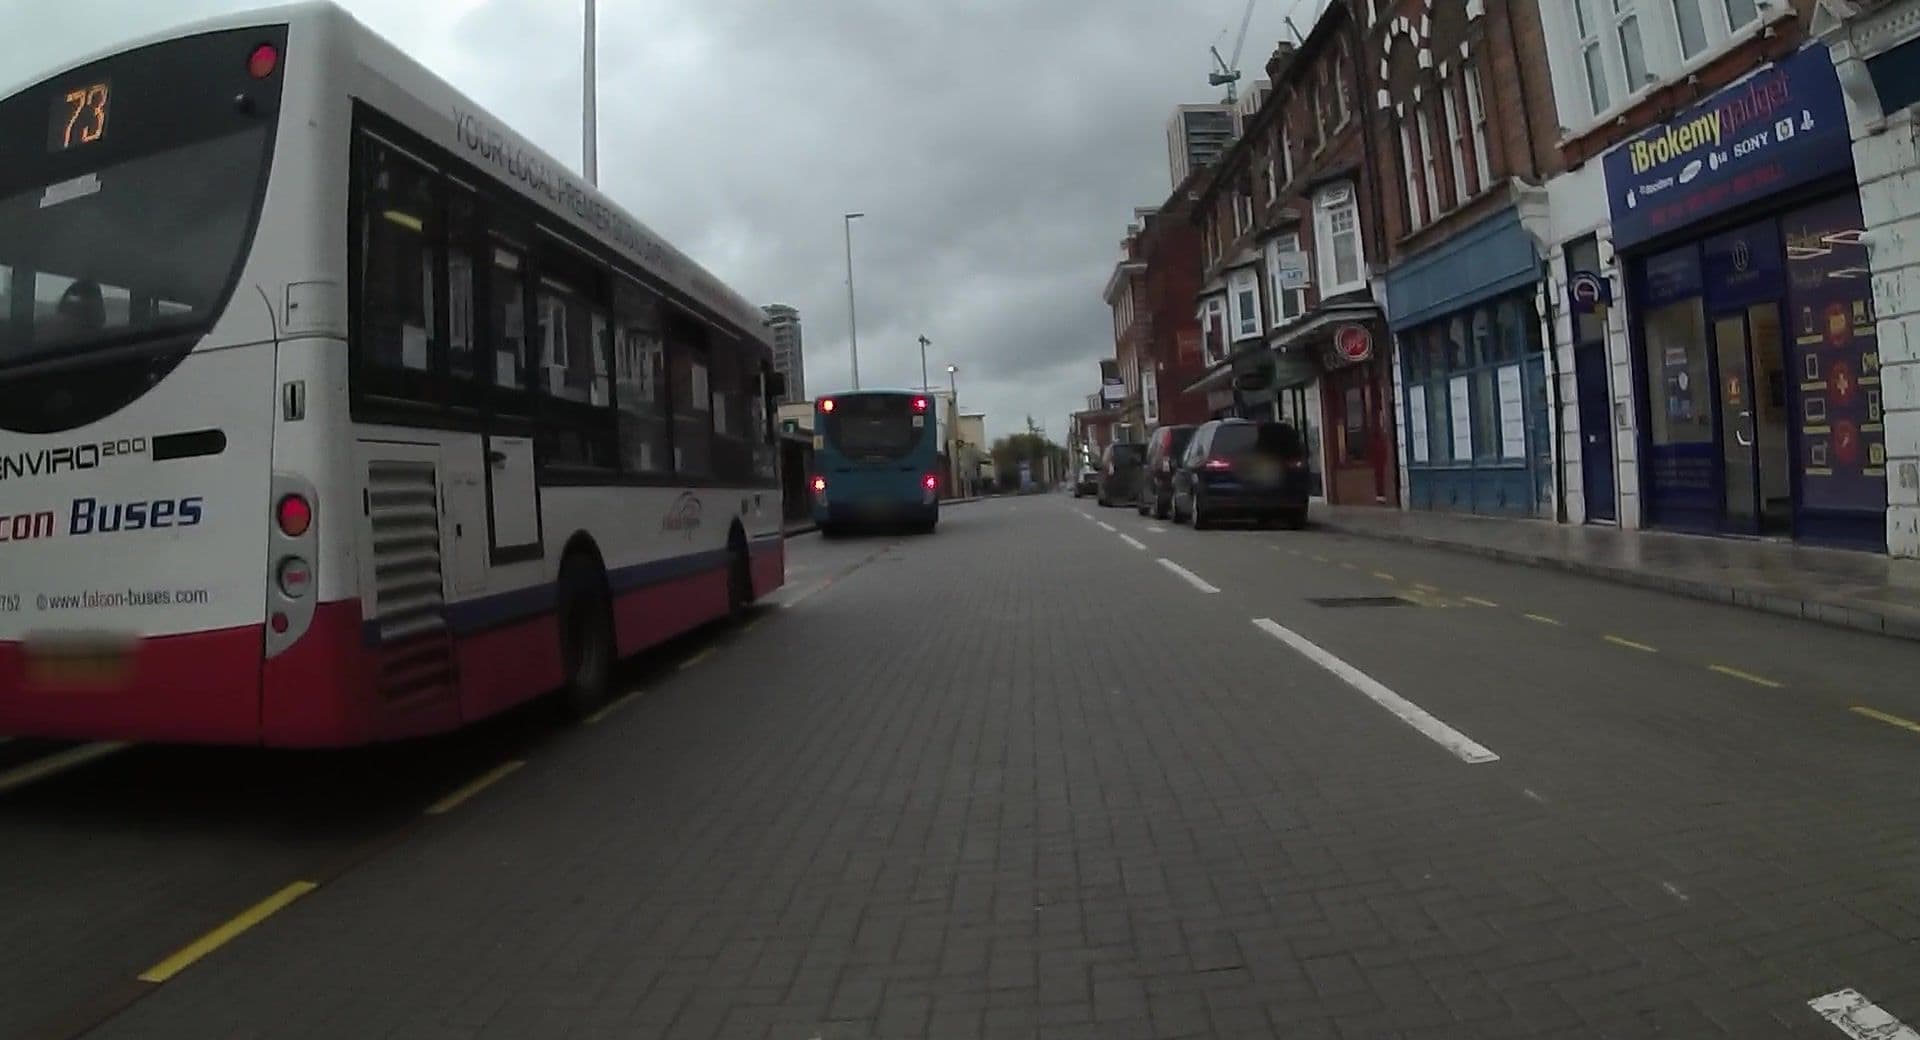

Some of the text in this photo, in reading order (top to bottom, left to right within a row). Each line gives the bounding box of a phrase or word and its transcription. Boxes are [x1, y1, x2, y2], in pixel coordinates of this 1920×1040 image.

[63, 82, 109, 148] 73
[452, 105, 503, 166] YOUR
[1734, 131, 1769, 158] SONY
[0, 437, 147, 480] NVIRO200
[69, 496, 204, 536] Buses
[0, 592, 21, 612] 752
